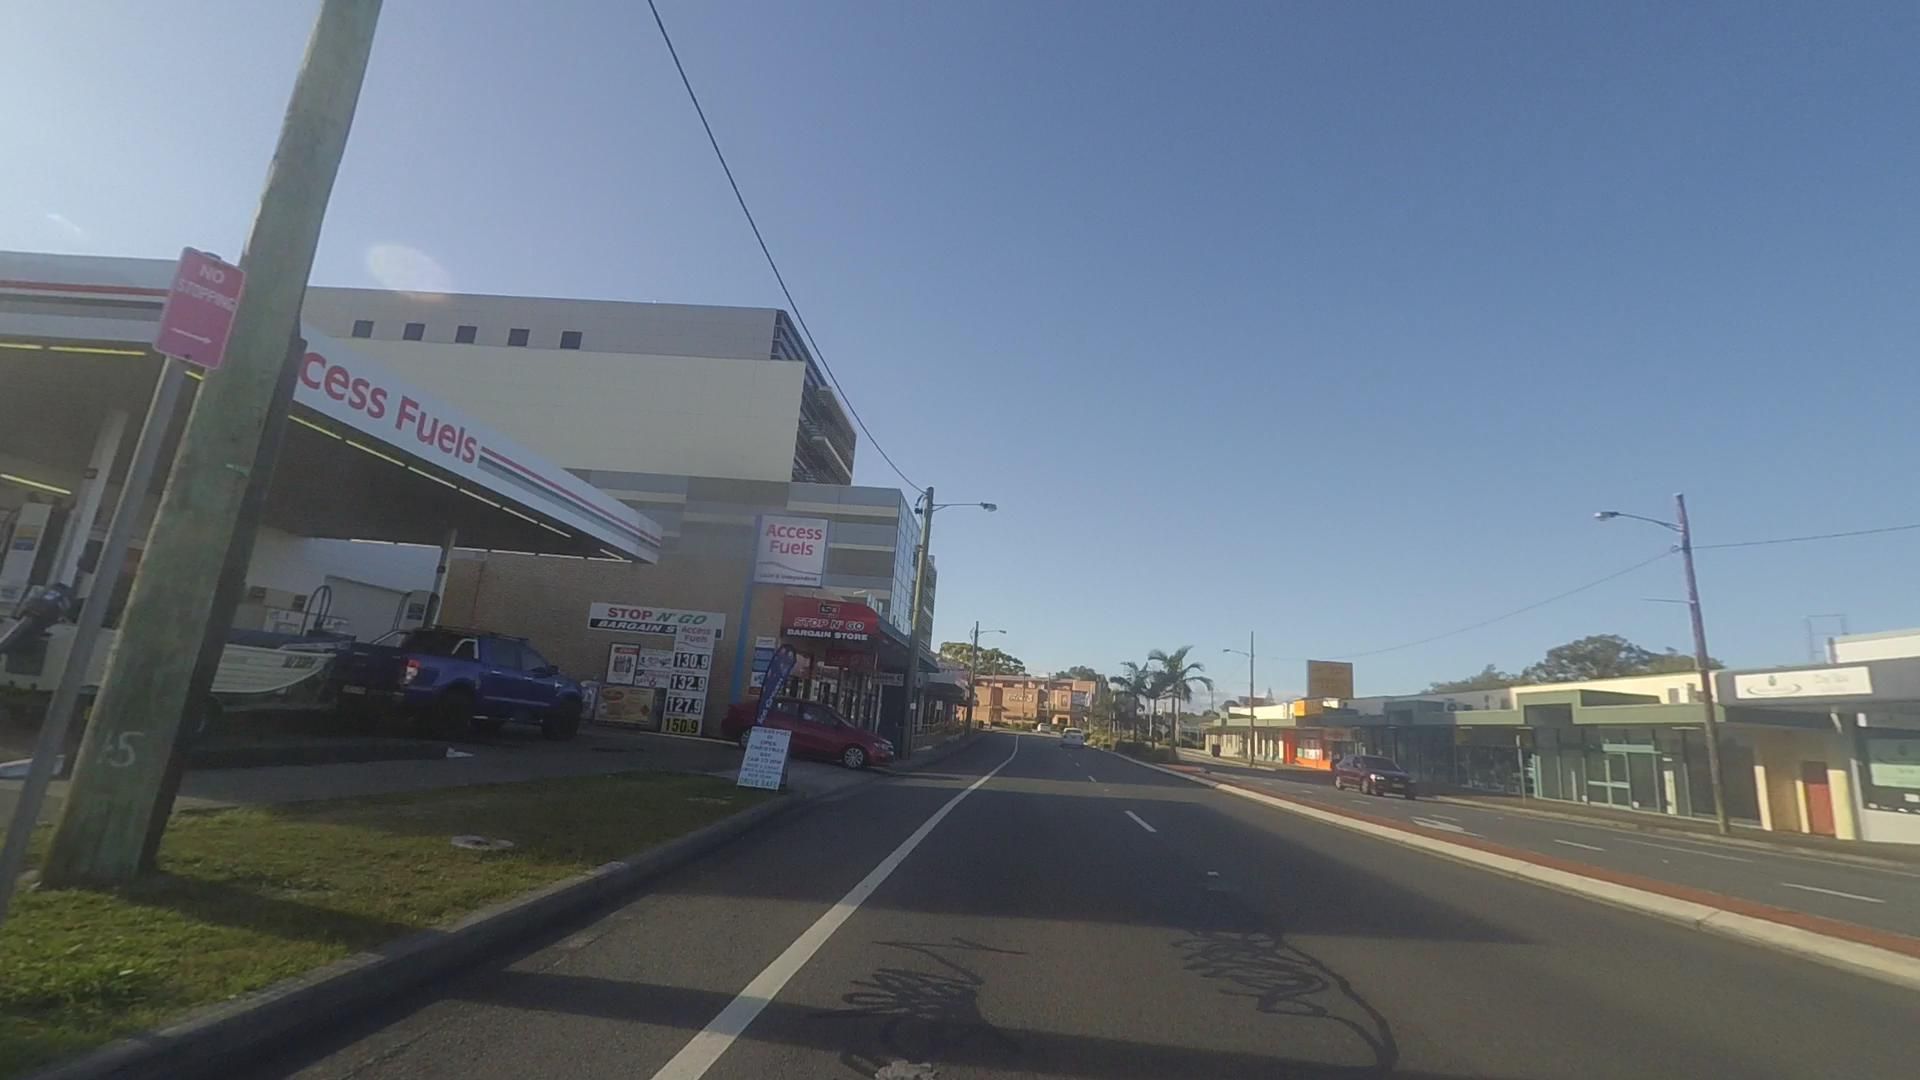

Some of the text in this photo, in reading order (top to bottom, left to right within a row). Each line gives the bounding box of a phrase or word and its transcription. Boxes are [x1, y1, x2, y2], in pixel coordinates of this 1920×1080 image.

[200, 264, 225, 285] NO
[300, 352, 477, 464] cess Fuels
[766, 524, 823, 541] Access
[769, 541, 814, 556] Fuels
[607, 607, 653, 620] STOP
[678, 614, 708, 625] GO
[597, 620, 662, 633] BARGAIN
[681, 625, 712, 635] Access
[793, 617, 829, 628] STOP
[845, 621, 865, 631] GO
[786, 629, 869, 640] BARGAIN STORE
[676, 653, 709, 669] 130.9
[672, 675, 705, 690] 132.9
[668, 697, 702, 713] 127.9
